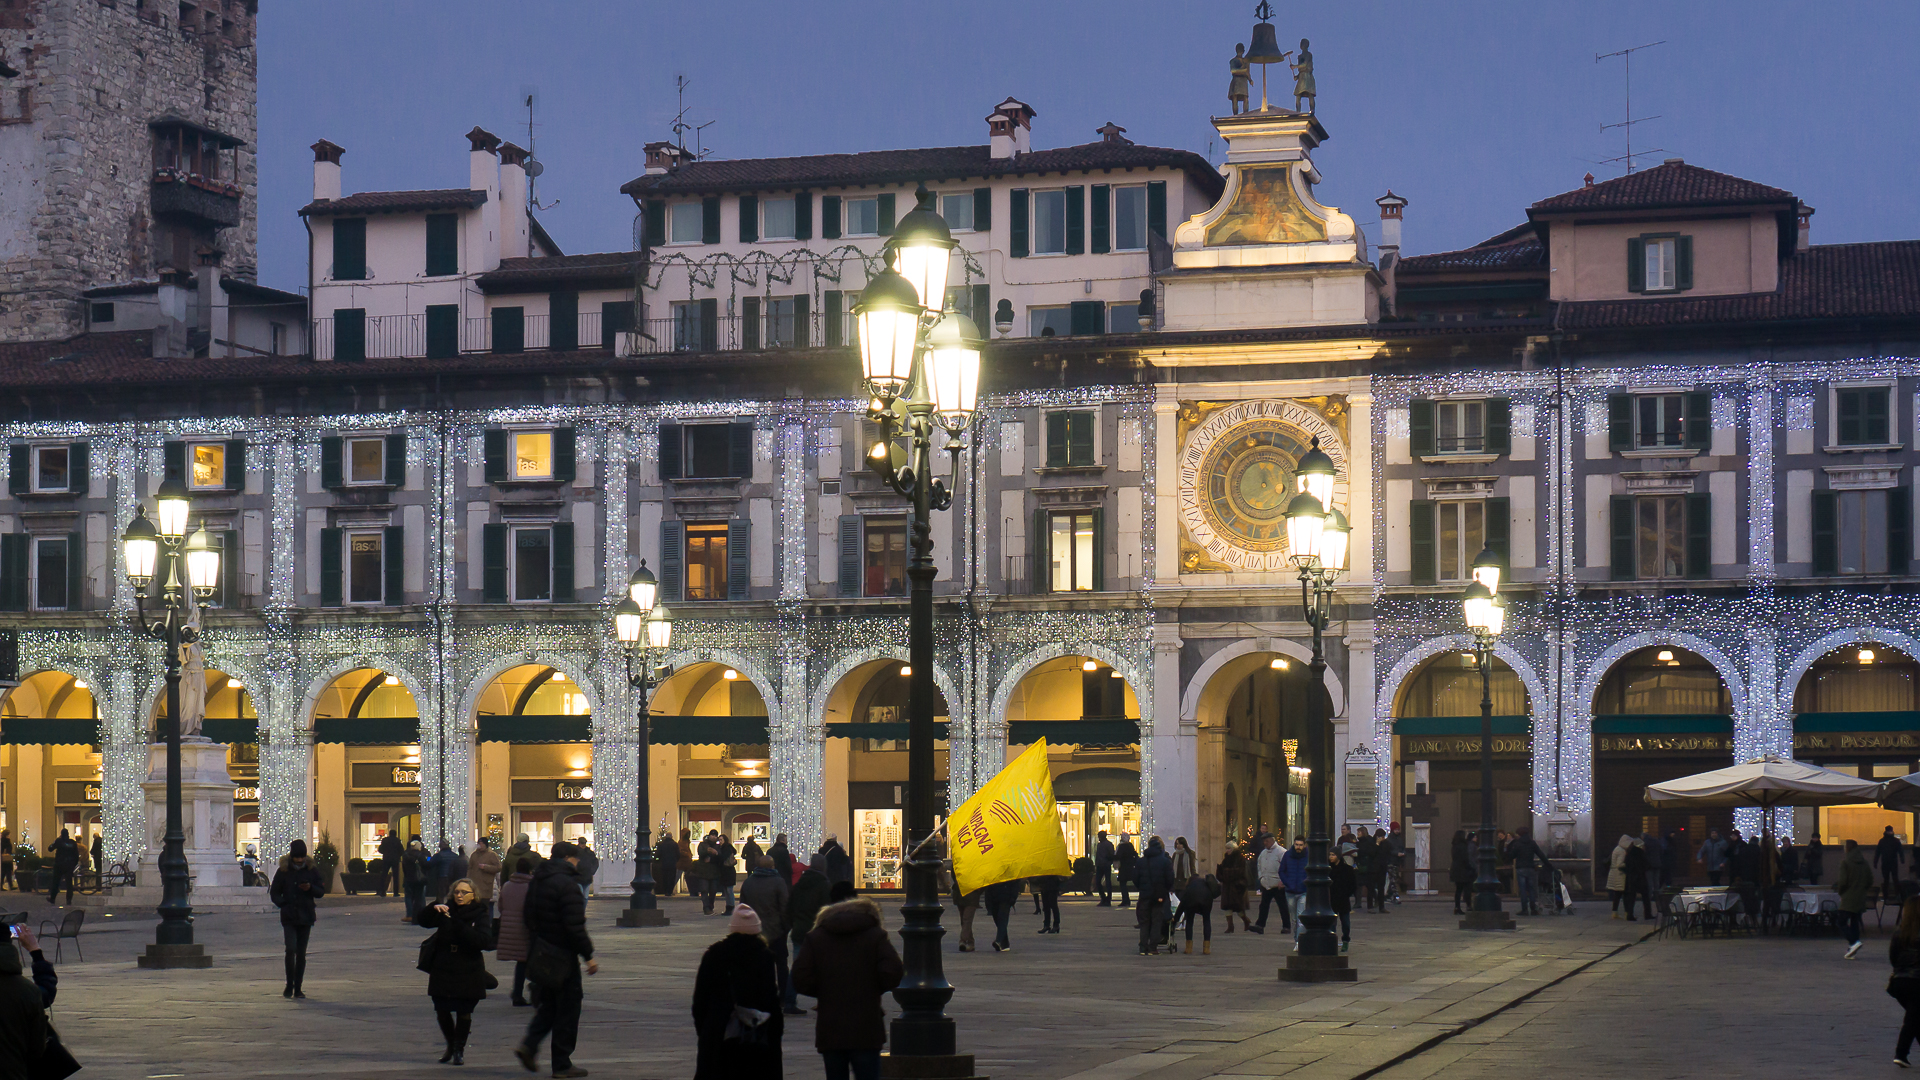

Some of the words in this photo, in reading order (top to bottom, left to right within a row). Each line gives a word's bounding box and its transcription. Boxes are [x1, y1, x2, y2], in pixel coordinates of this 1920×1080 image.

[1284, 406, 1301, 422] XX
[1301, 413, 1320, 431] XXI
[1207, 416, 1226, 436] XVI
[1194, 431, 1210, 451] XV
[1316, 427, 1334, 447] XXII
[1182, 470, 1195, 486] XIII
[1182, 490, 1195, 507] XII
[1187, 511, 1202, 525] XI
[1197, 528, 1211, 541] X
[352, 540, 381, 552] fasoli
[1226, 549, 1242, 566] VIII
[1248, 555, 1263, 568] VII
[1270, 556, 1283, 568] VI
[1409, 740, 1451, 753] BANCA
[1456, 740, 1529, 753] PASDORE
[1600, 738, 1643, 751] BANCA
[84, 784, 103, 800] fa
